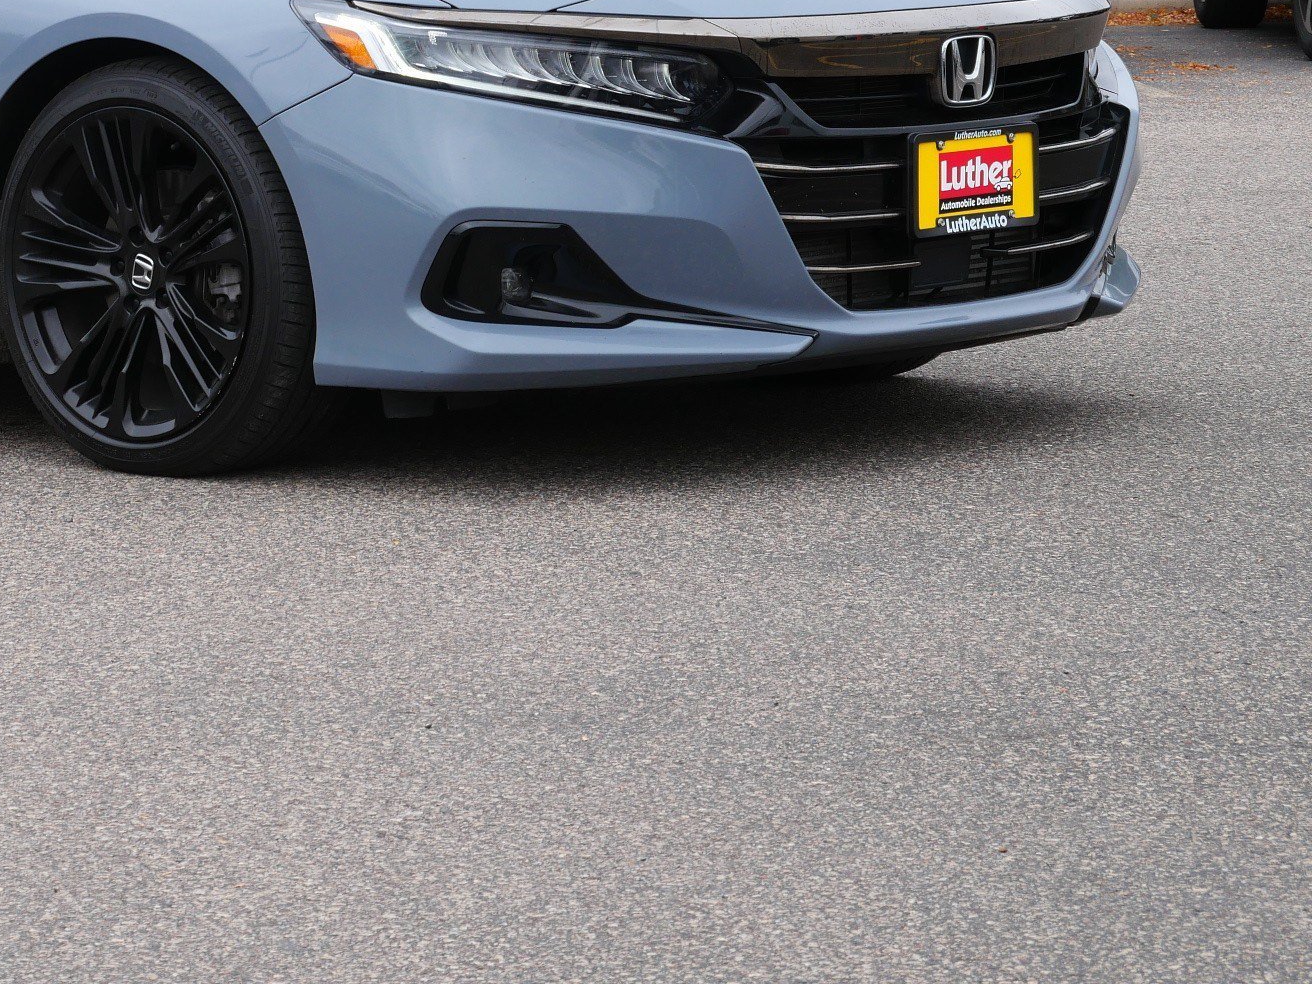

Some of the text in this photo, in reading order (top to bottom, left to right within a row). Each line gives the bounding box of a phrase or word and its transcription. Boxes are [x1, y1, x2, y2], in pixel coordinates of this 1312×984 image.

[954, 129, 1002, 140] LutherAuto.com
[940, 156, 1013, 192] Luther
[940, 194, 1012, 211] Automobile Dealerships
[946, 213, 1008, 234] LutherAuto
